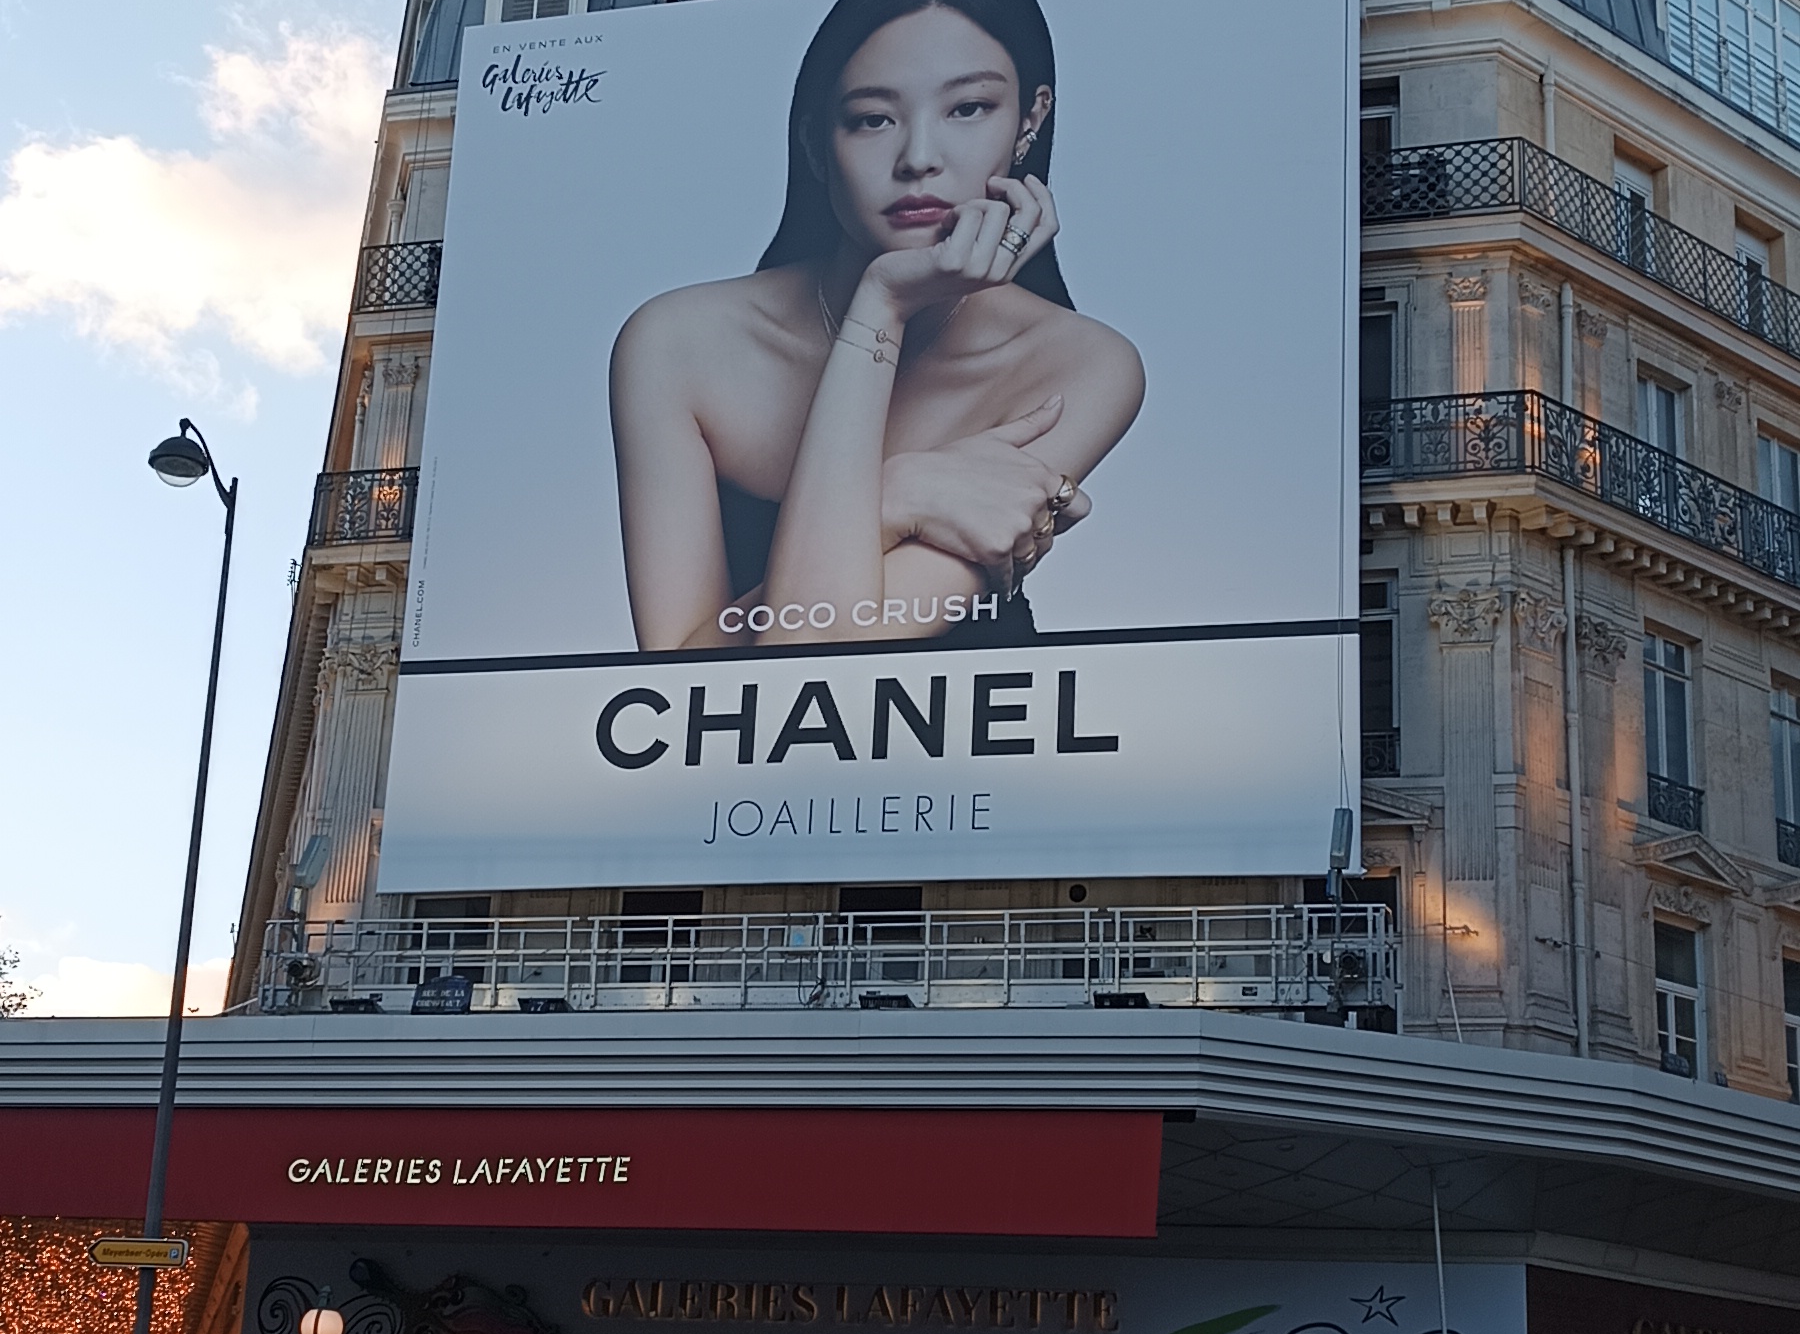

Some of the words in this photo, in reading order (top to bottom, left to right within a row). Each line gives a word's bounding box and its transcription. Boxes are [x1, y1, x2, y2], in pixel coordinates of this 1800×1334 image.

[492, 45, 511, 54] EN
[519, 39, 566, 51] VENTE
[574, 35, 603, 45] AUX
[482, 54, 563, 95] Galeries
[501, 68, 608, 116] Lafayette
[412, 579, 425, 647] CHANEL.COM
[717, 600, 837, 635] COCO
[851, 592, 1000, 628] CRUSH
[595, 669, 1119, 770] CHANEL
[704, 793, 993, 844] JOAILLERIE
[455, 989, 465, 997] LA
[287, 1157, 442, 1185] GALERIES
[453, 1155, 632, 1186] LAFAYETTE
[582, 1277, 818, 1324] GALERIES
[835, 1283, 1120, 1334] LAFAYETTE
